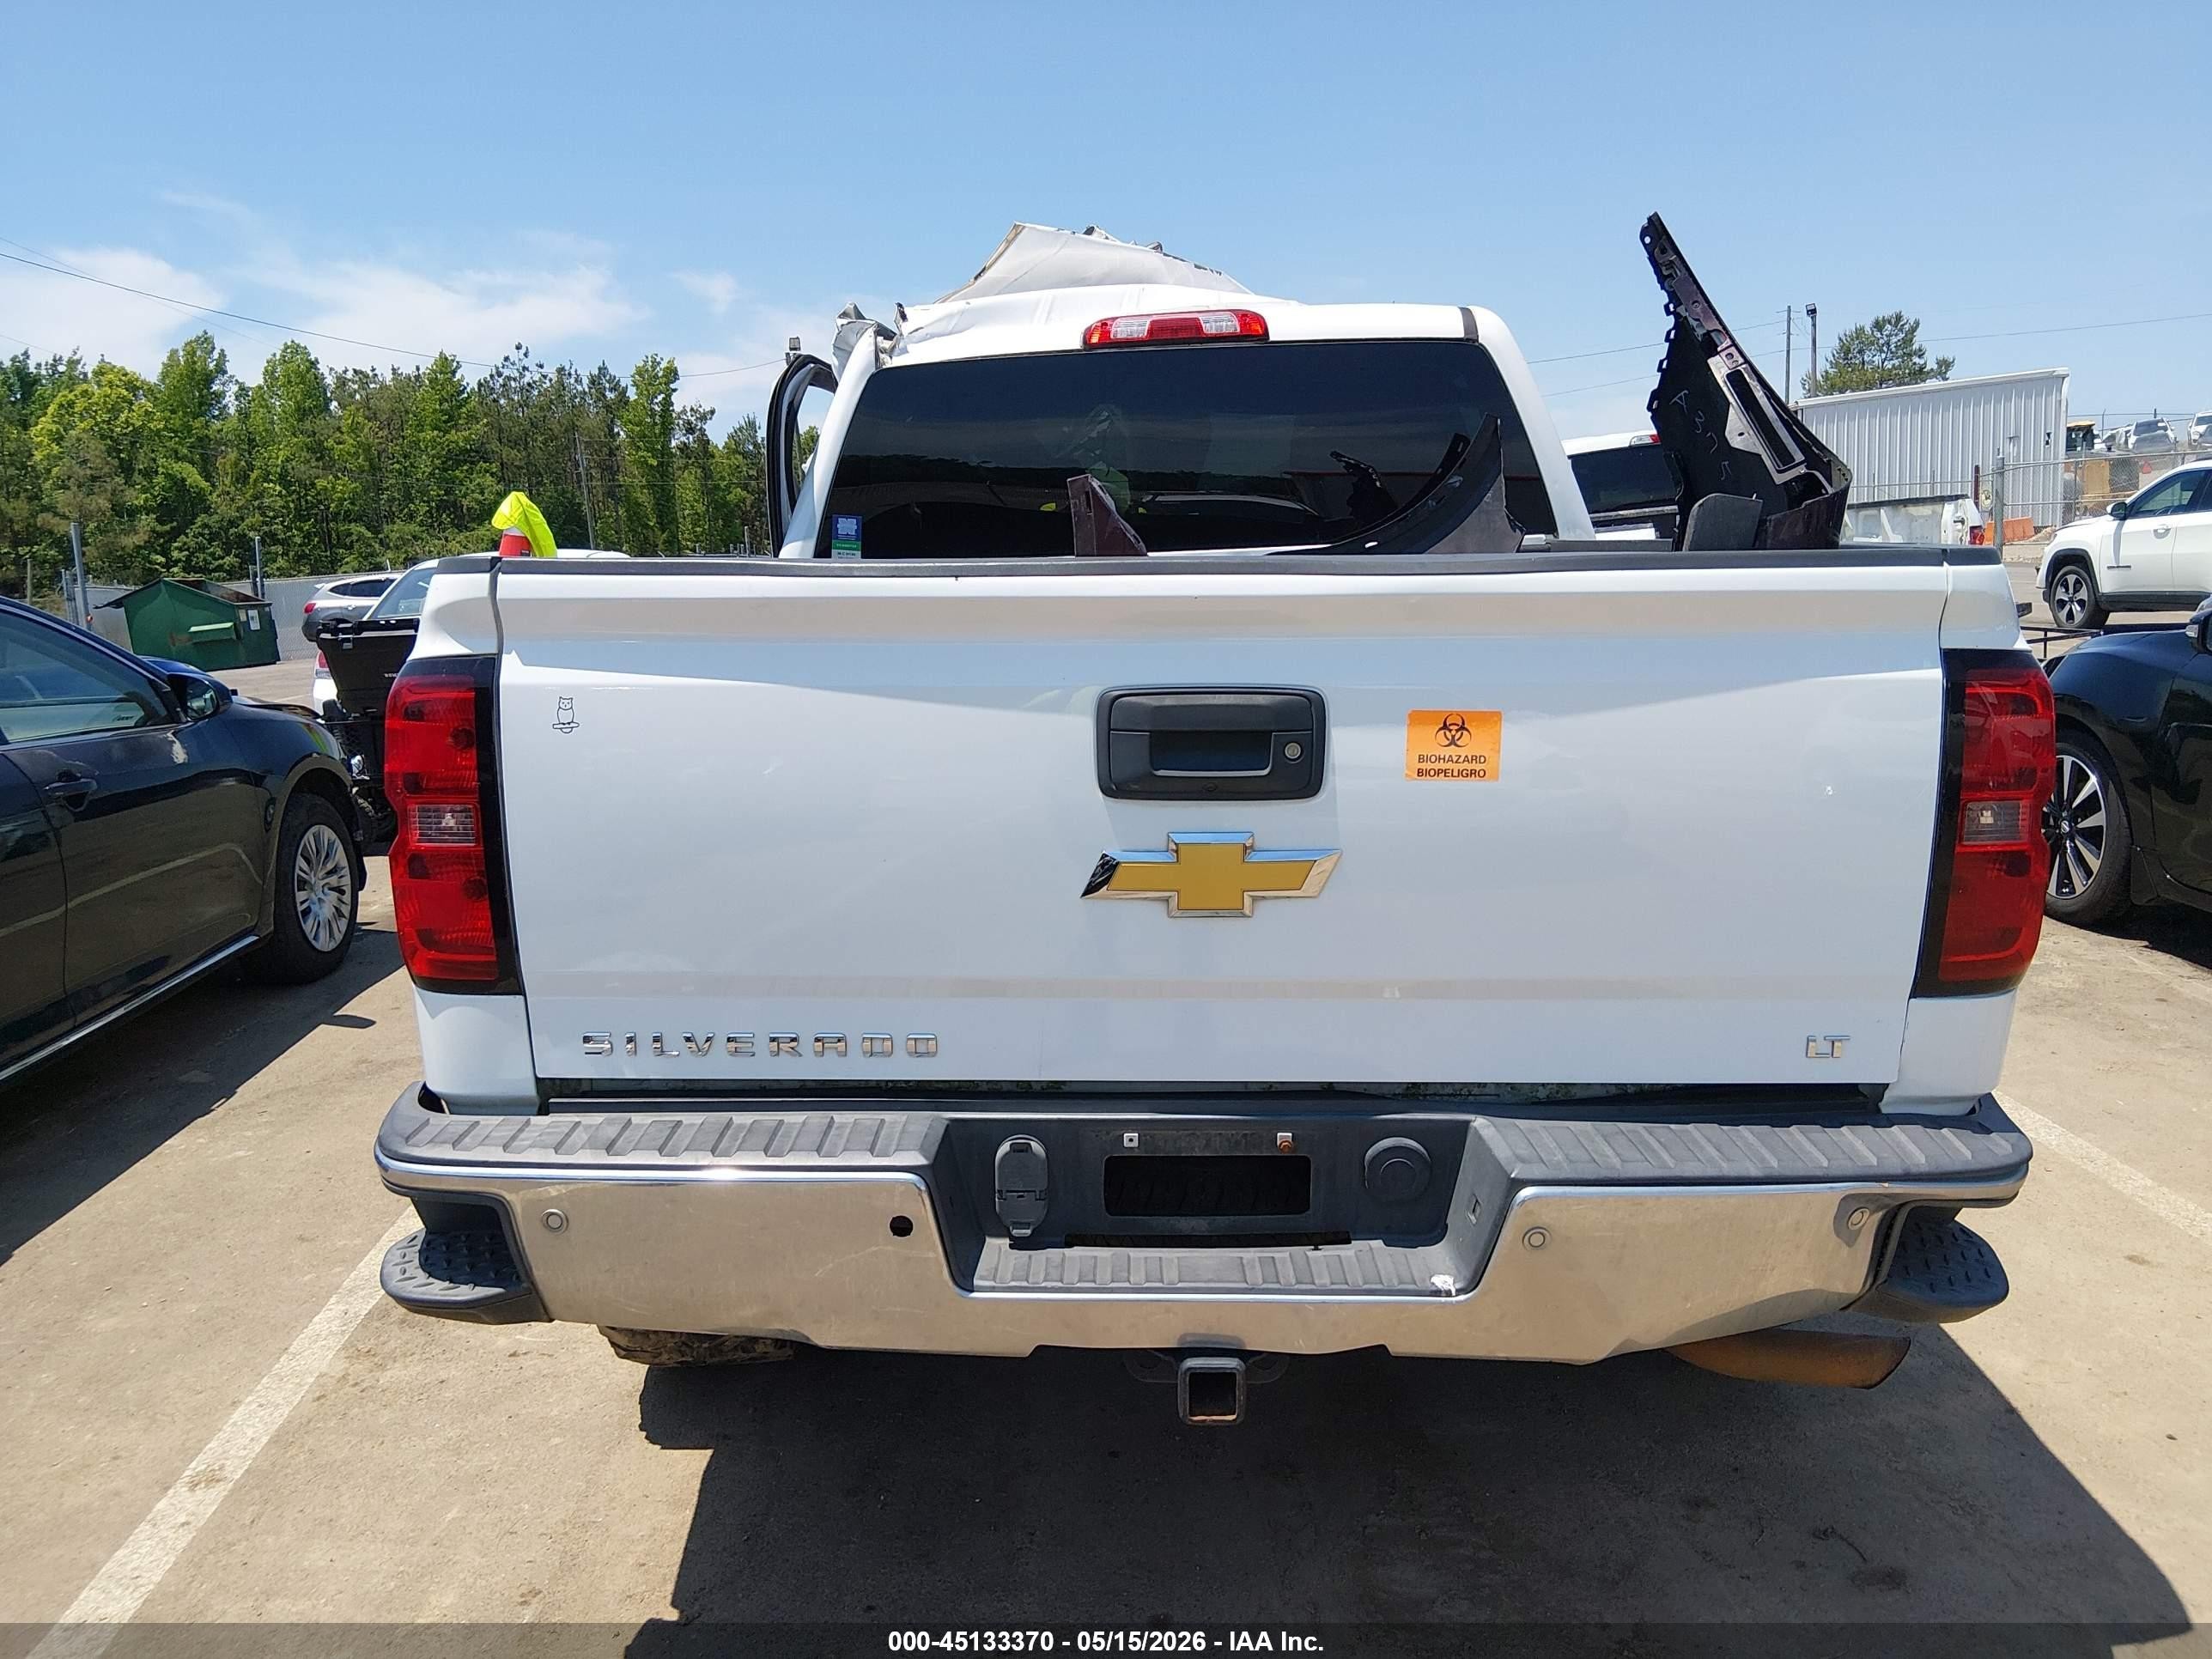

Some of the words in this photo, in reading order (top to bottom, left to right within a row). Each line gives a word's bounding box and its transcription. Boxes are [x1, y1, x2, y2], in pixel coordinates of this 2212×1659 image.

[1418, 754, 1487, 765] BIOHAZARD
[1417, 768, 1487, 778] BIOPELIGRO
[582, 1031, 939, 1058] SILVERADO
[1806, 1035, 1850, 1059] LT
